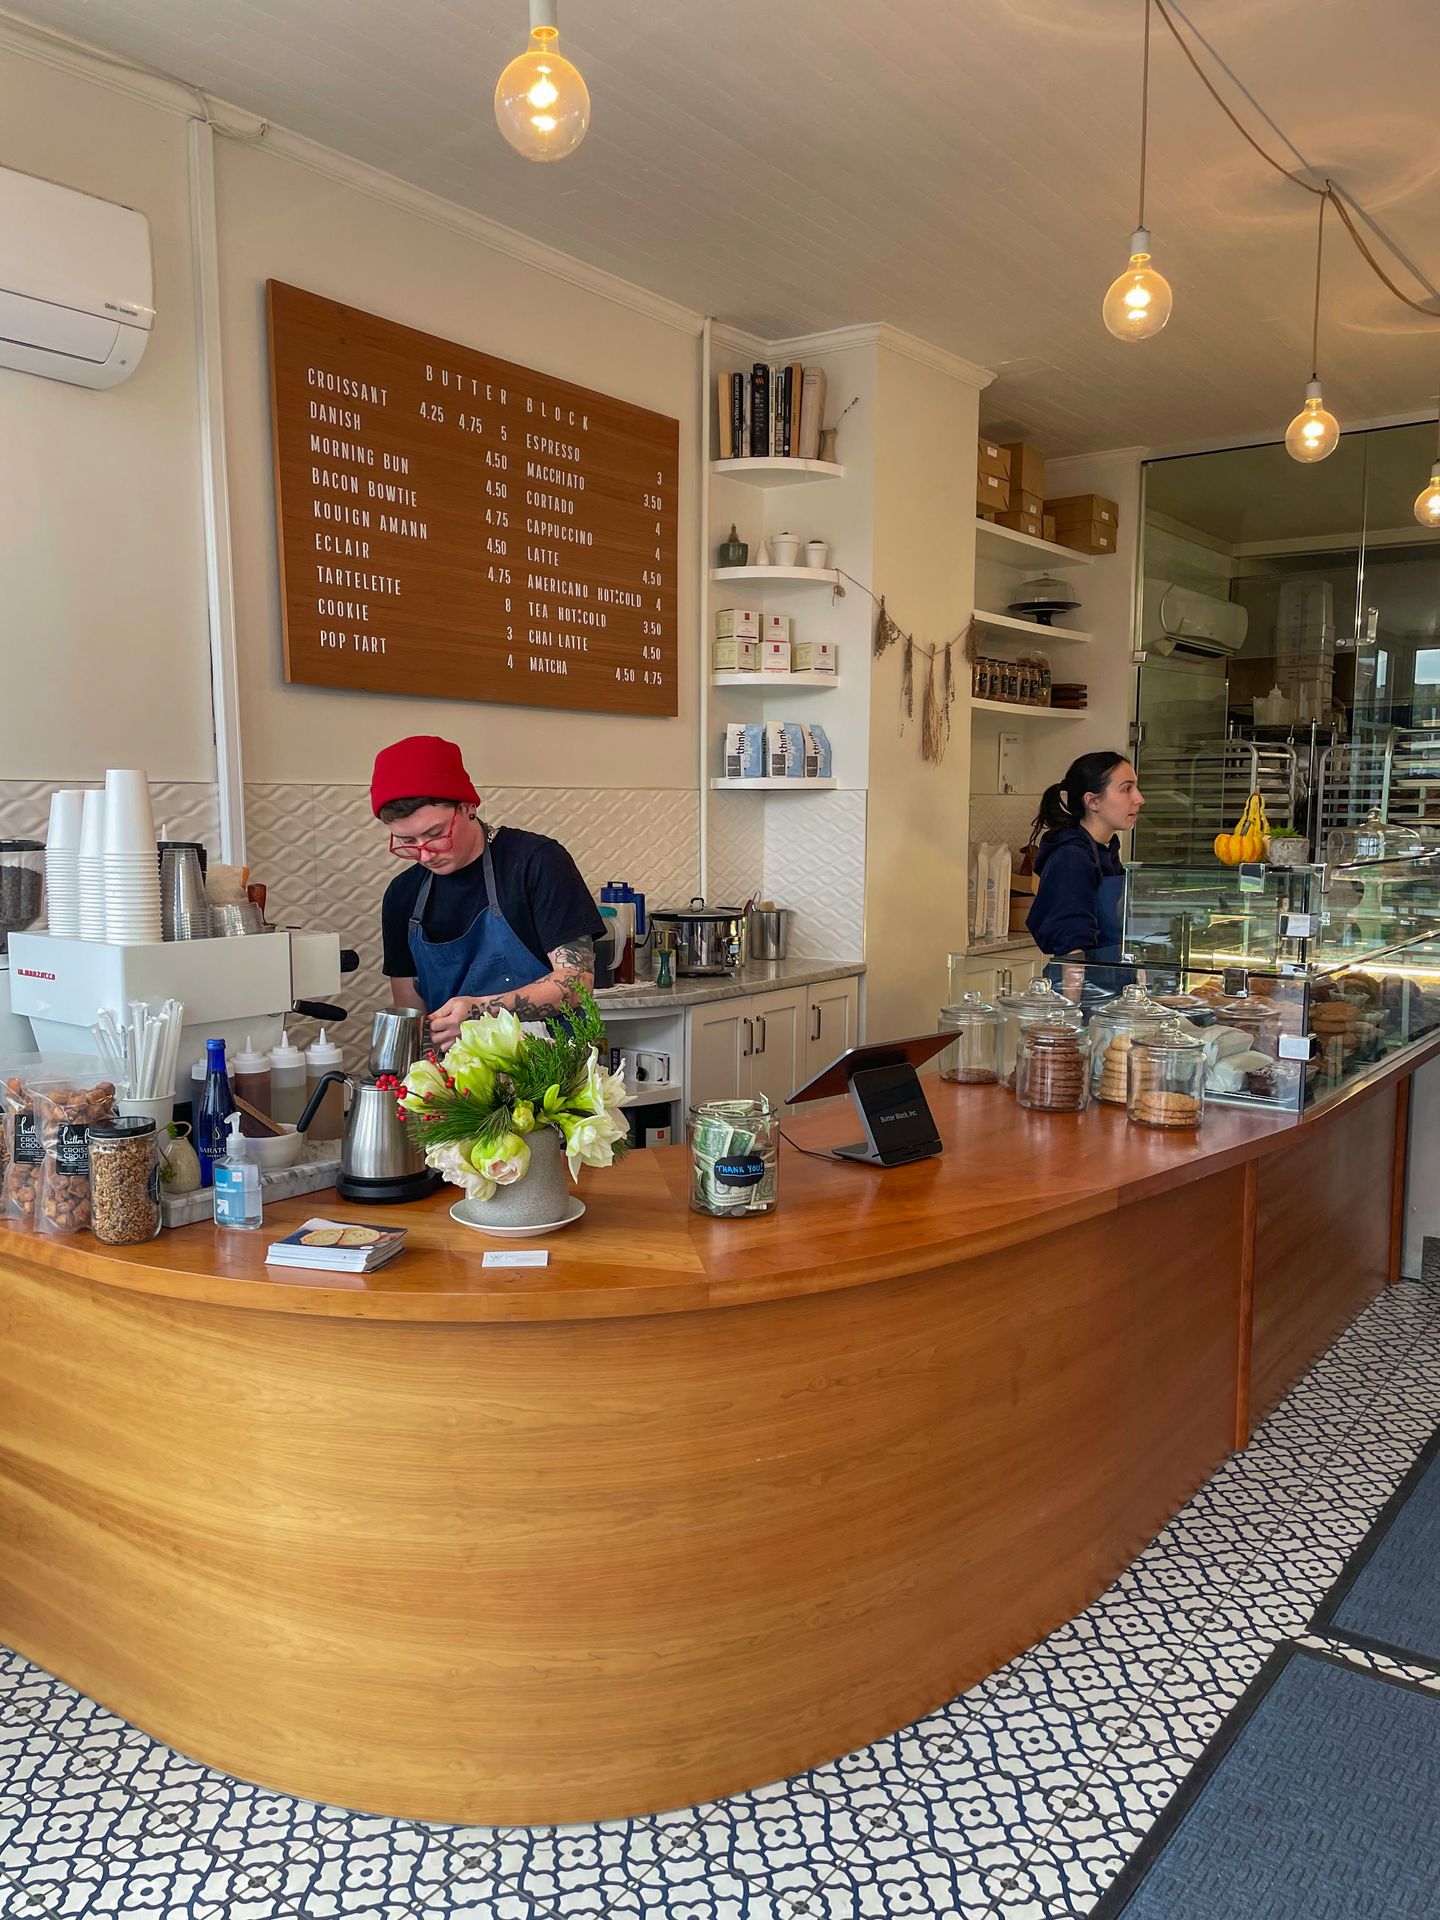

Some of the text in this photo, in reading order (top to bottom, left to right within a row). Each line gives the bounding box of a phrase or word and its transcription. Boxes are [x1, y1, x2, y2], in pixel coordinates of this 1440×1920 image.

[308, 367, 507, 441] CROISSANT 4.25 4.75 5
[426, 364, 589, 431] BUTTER BLOCK
[310, 400, 508, 470] DANISH 4.50
[310, 434, 507, 499] MORNING BUN 4.50
[526, 433, 663, 486] ESPRESSO 3
[311, 467, 509, 528] BACON BOWTIE 4.75
[527, 461, 662, 511] MACCHIATO 3.50
[313, 500, 507, 556] KOUIGN AMANN 4.50
[526, 490, 661, 537] CORTADO 4
[315, 533, 511, 585] ECLAIR 4.75
[527, 518, 661, 562] CAPPUCCINO 4
[527, 546, 662, 587] LATTE 4.50
[316, 565, 512, 613] TARTELETTE 8
[527, 574, 589, 598] AMERICANO
[655, 598, 661, 612] 4
[318, 597, 513, 641] COOKIE 3
[528, 601, 549, 619] TEA
[643, 620, 662, 636] 3.50
[320, 629, 513, 669] POP TART 4
[528, 629, 661, 661] CHAI LATTE 4.50
[529, 656, 662, 685] MATCHA 4.50 4.75
[736, 731, 745, 755] think
[777, 729, 787, 754] think
[808, 732, 819, 755] think
[715, 1163, 764, 1174] THANK YOU!
